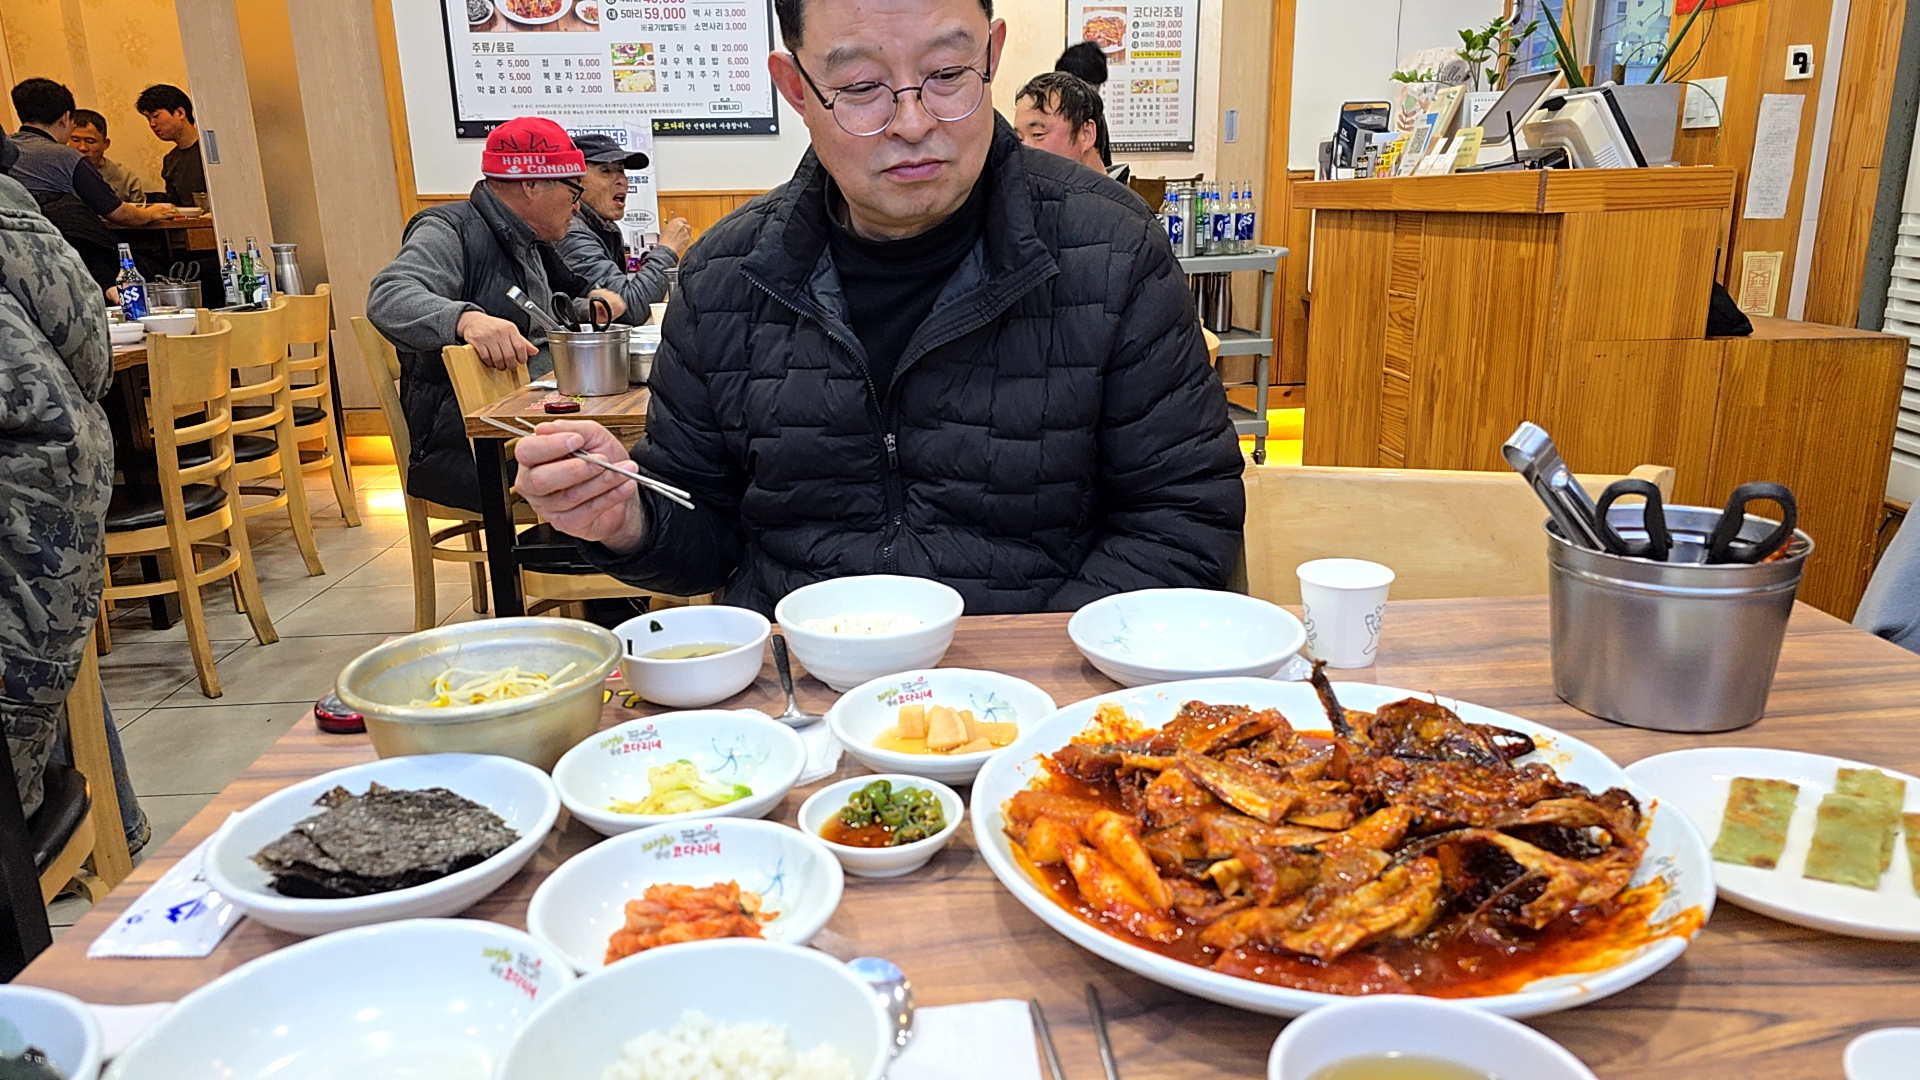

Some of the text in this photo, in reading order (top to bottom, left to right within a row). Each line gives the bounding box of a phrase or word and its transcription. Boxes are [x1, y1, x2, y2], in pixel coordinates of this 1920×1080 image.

[620, 9, 643, 19] 5마리
[644, 7, 686, 21] 59,000
[724, 8, 746, 18] 3,000
[1133, 6, 1183, 18] 코다리조림
[694, 22, 747, 31] 소면사리 3,000
[1156, 20, 1182, 29] 39,000
[1155, 30, 1182, 39] 49,000
[472, 42, 515, 53] 주류/음료
[721, 44, 748, 53] 20,000
[1155, 40, 1182, 49] 59,000
[507, 59, 530, 68] 5,000
[578, 58, 600, 67] 6,000
[727, 57, 749, 66] 6,000
[509, 72, 531, 81] 5,000
[575, 71, 601, 81] 12,000
[728, 70, 750, 79] 2,000
[510, 85, 533, 94] 4,000
[580, 85, 603, 94] 2,000
[729, 83, 751, 92] 1,000
[502, 155, 546, 165] HAHU
[527, 163, 581, 174] CANADA
[119, 286, 140, 306] ass
[623, 739, 662, 754] 코다리네
[673, 842, 721, 858] 코다리네
